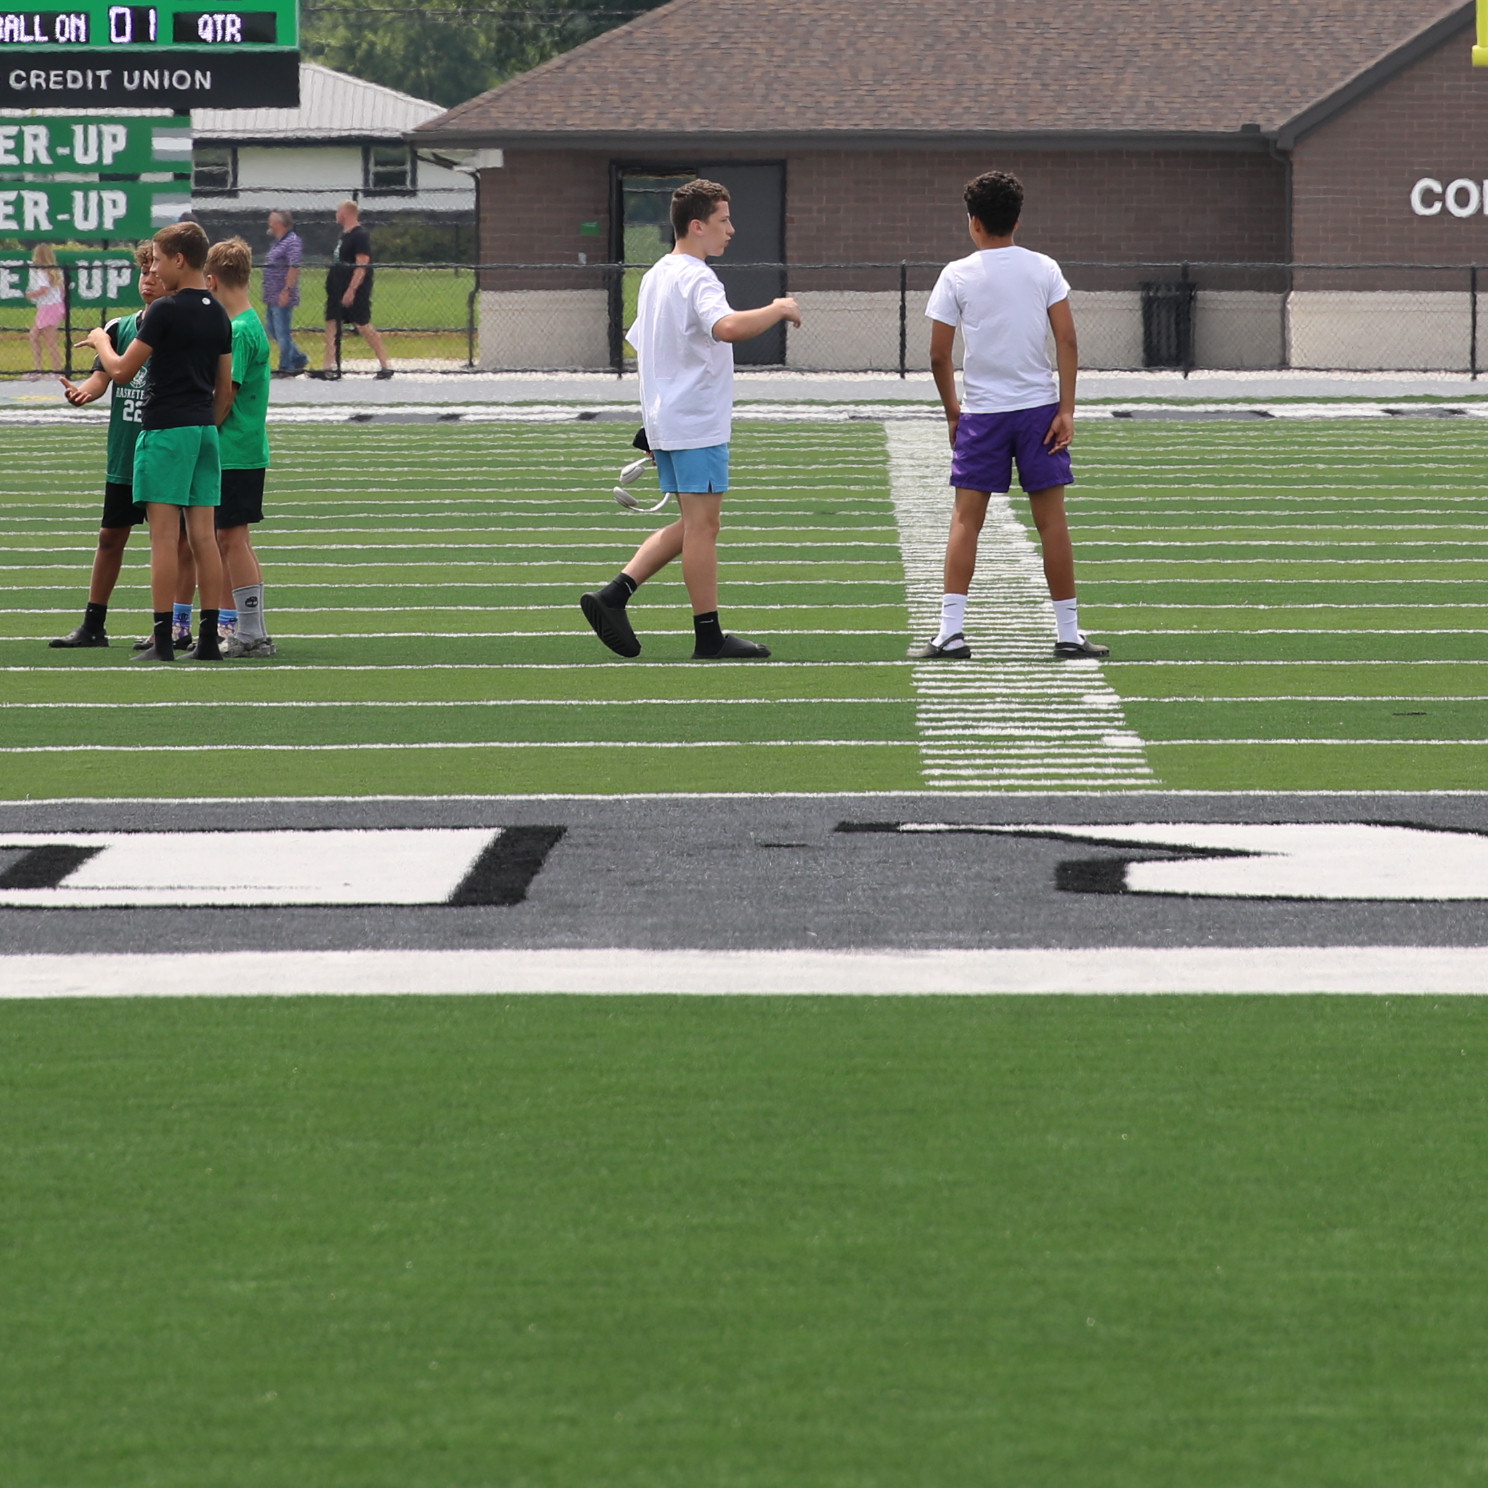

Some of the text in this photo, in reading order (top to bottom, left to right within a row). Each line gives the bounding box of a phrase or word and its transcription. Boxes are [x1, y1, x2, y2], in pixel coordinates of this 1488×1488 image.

[55, 14, 86, 43] ON
[197, 14, 241, 43] QTR
[9, 69, 111, 90] CREDIT
[123, 69, 212, 90] UNION
